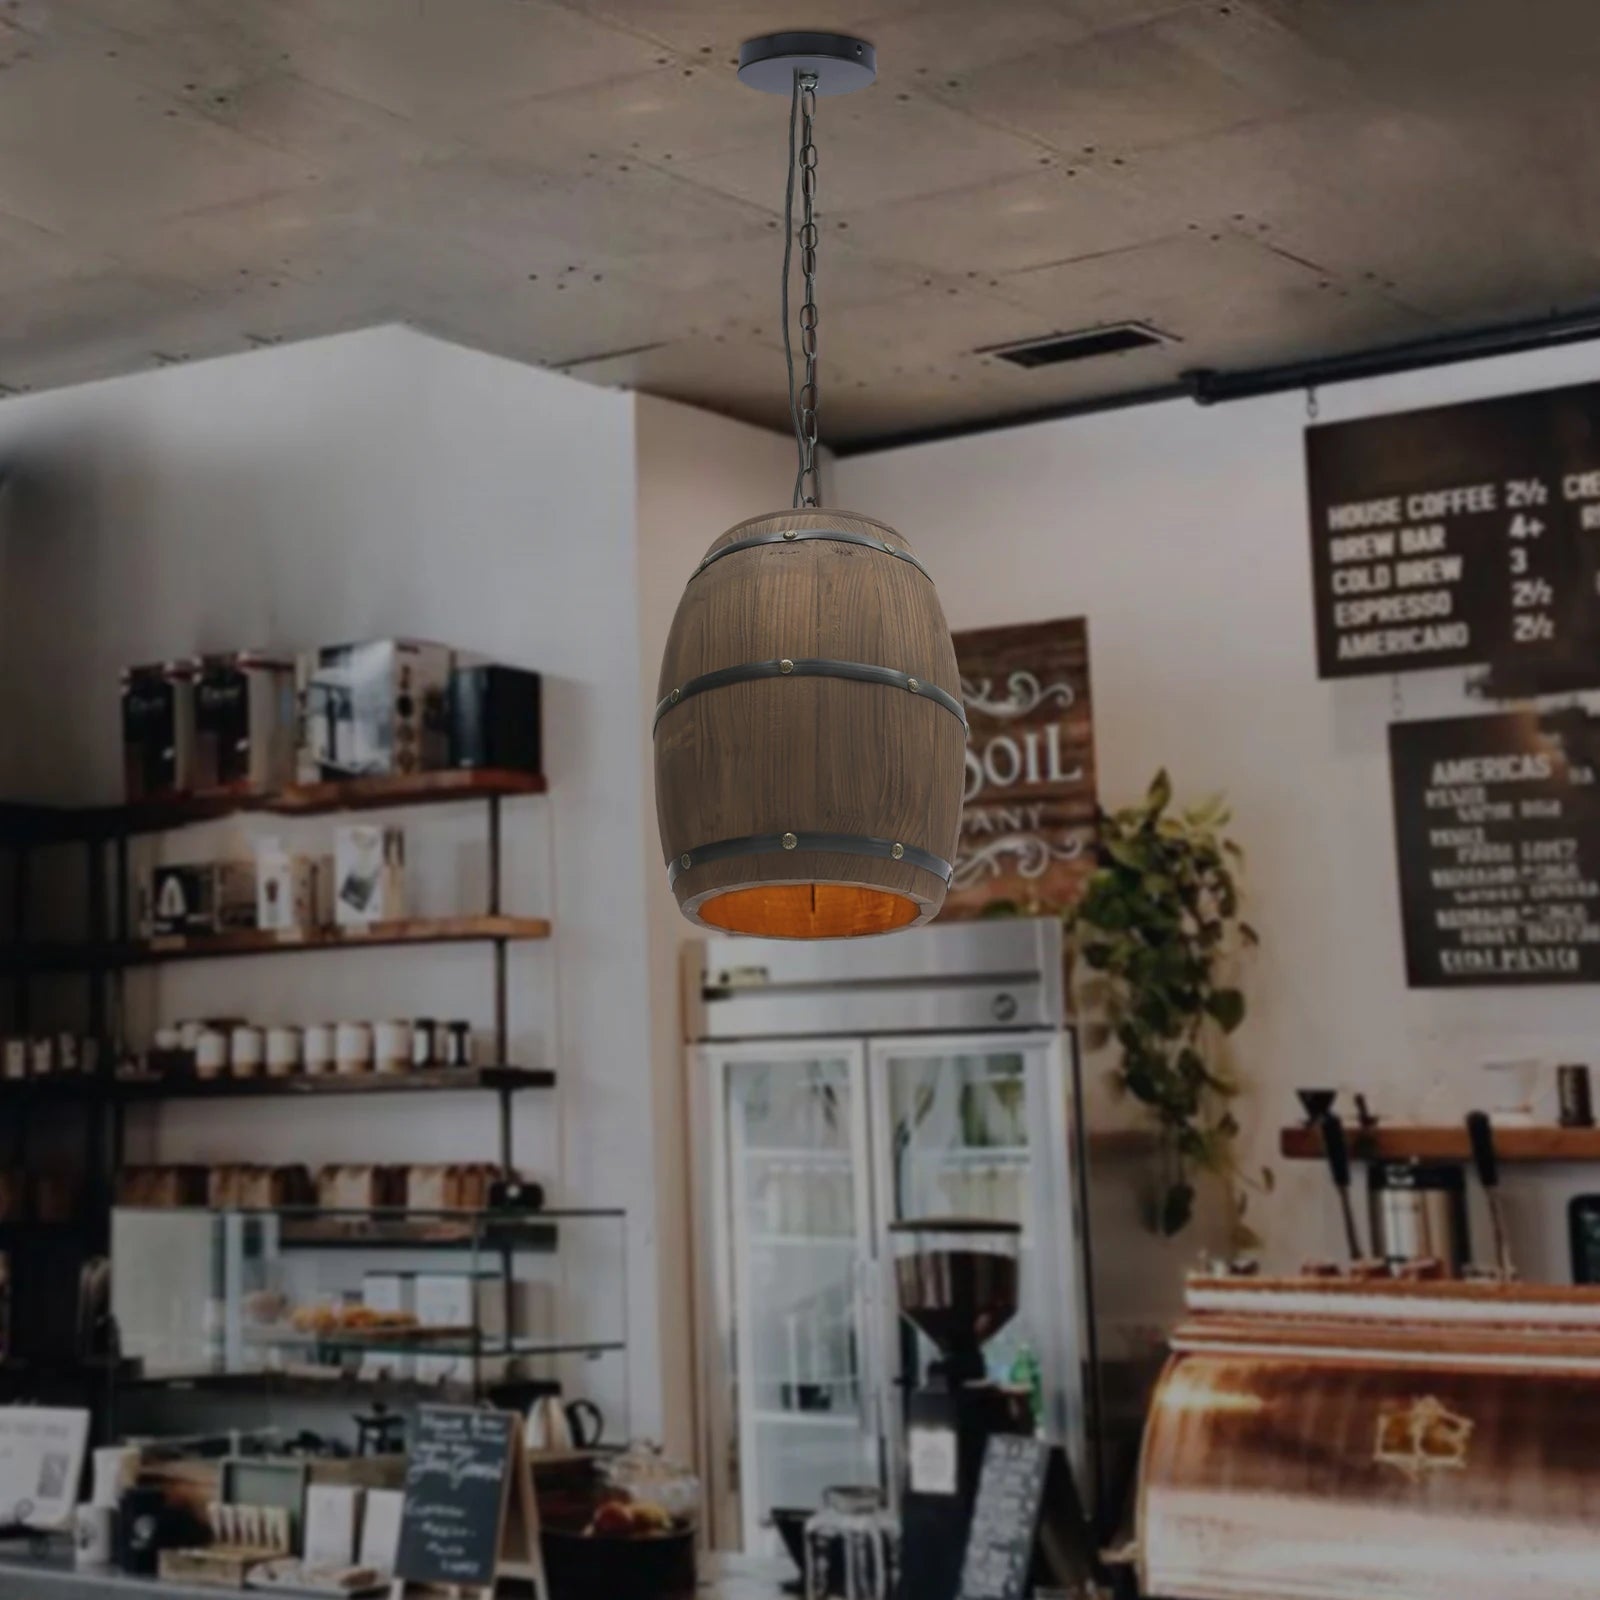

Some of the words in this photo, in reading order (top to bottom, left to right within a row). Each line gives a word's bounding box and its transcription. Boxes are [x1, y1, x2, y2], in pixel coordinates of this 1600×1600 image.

[1328, 497, 1401, 531] HOUSE
[1407, 484, 1496, 520] COFFEE
[1330, 532, 1395, 563] BREW
[1400, 525, 1446, 554] BAR
[1509, 514, 1545, 539] 4+
[1332, 565, 1391, 595] COLD
[1396, 556, 1463, 588] BREW
[1510, 548, 1528, 573] 3
[1334, 590, 1452, 628] ESPRESSO
[1337, 622, 1469, 660] AMERICANO
[1432, 755, 1551, 785] AMERICAS
[964, 804, 1045, 833] ANY
